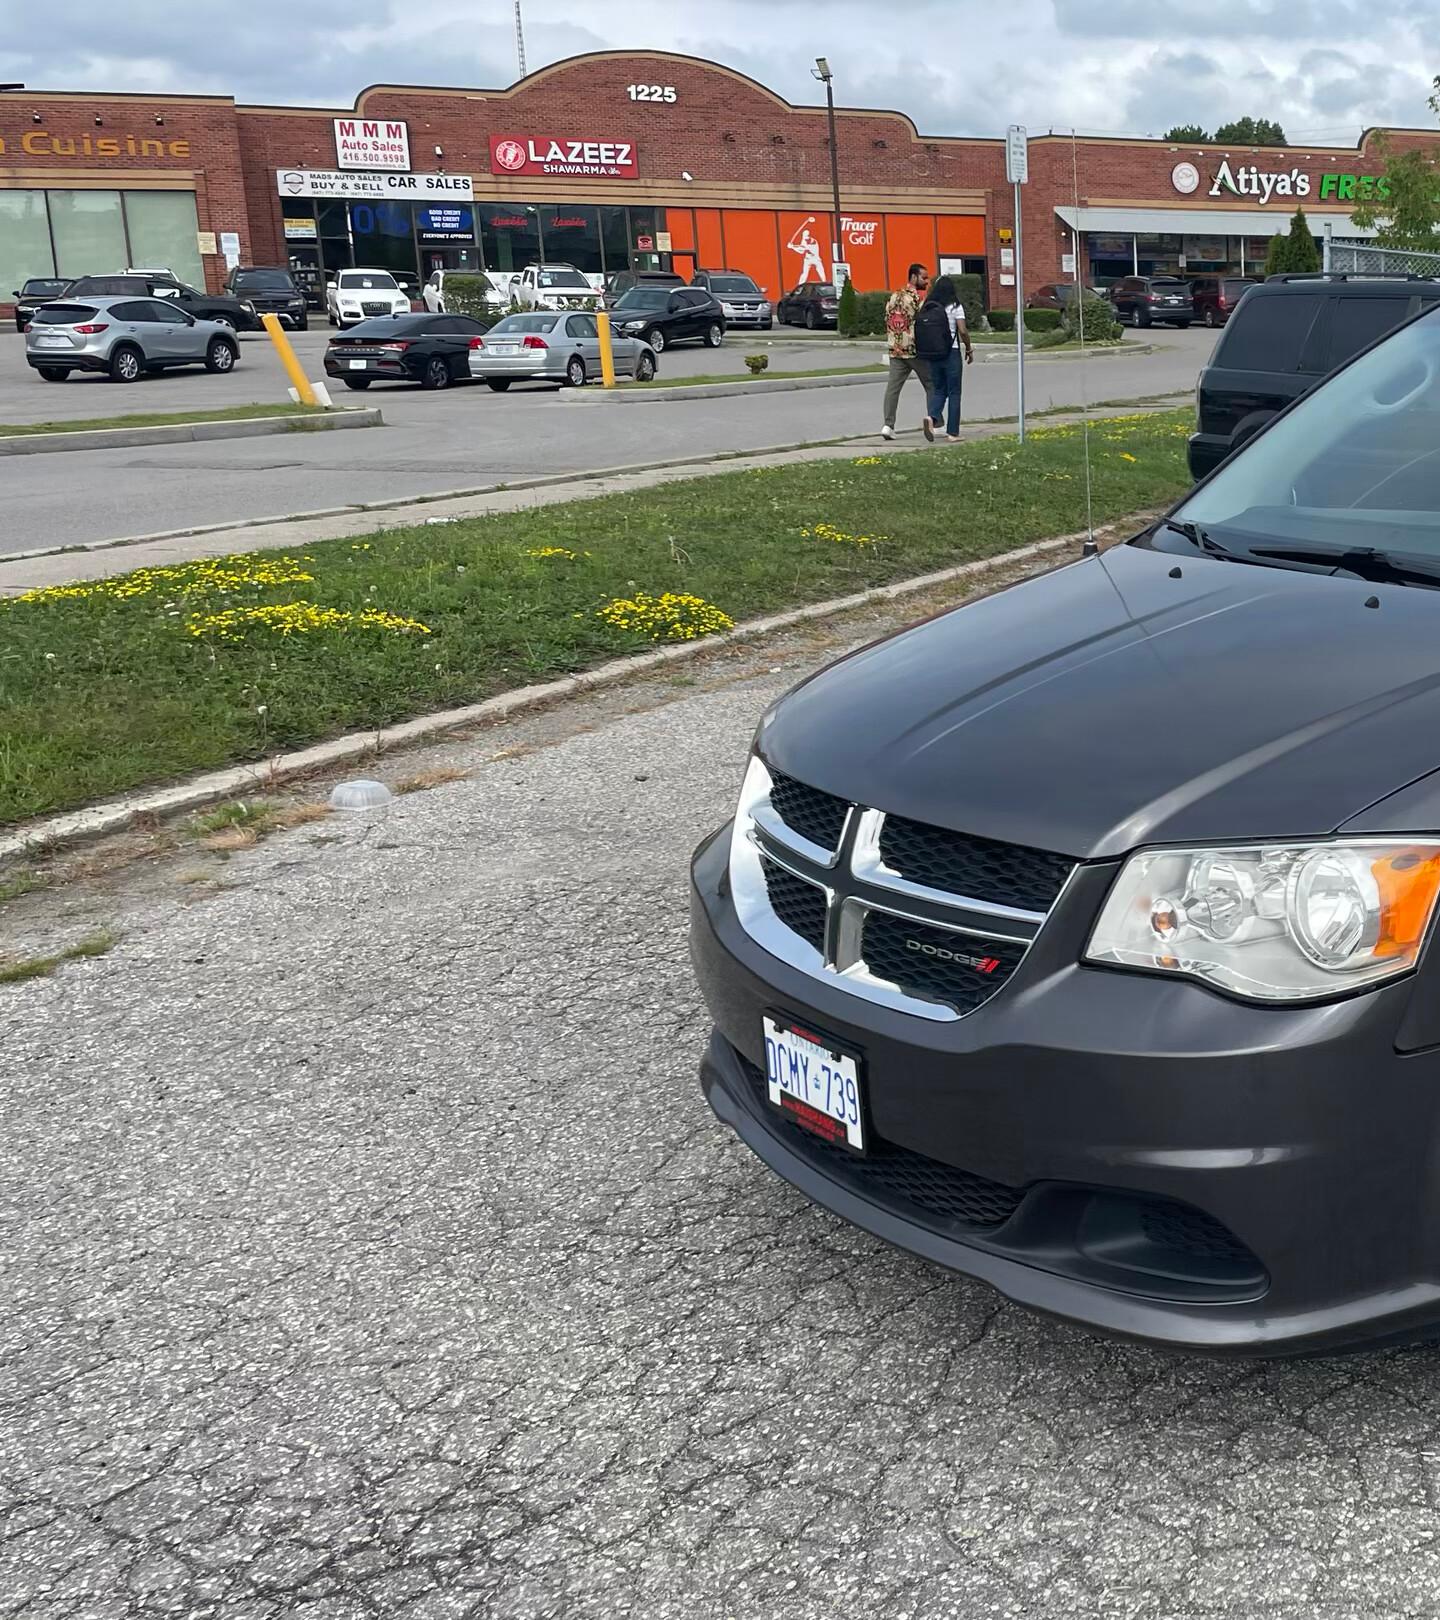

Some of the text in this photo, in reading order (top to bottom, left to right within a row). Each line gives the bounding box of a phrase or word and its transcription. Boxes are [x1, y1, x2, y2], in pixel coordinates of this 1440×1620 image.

[627, 84, 677, 103] 1225
[22, 131, 191, 158] Cuisine
[341, 139, 404, 152] Auto Sales
[528, 140, 632, 165] LAZEEZ
[543, 164, 607, 175] SHAWARMA
[311, 182, 384, 191] BUY & SELL
[388, 176, 470, 190] CAR SALES
[1208, 160, 1311, 205] Atiya's
[1319, 173, 1393, 201] FRES
[840, 217, 878, 232] Tracer
[849, 232, 874, 245] Golf
[906, 939, 987, 969] DODGE
[765, 1036, 808, 1100] DCMY
[821, 1063, 858, 1125] 739
